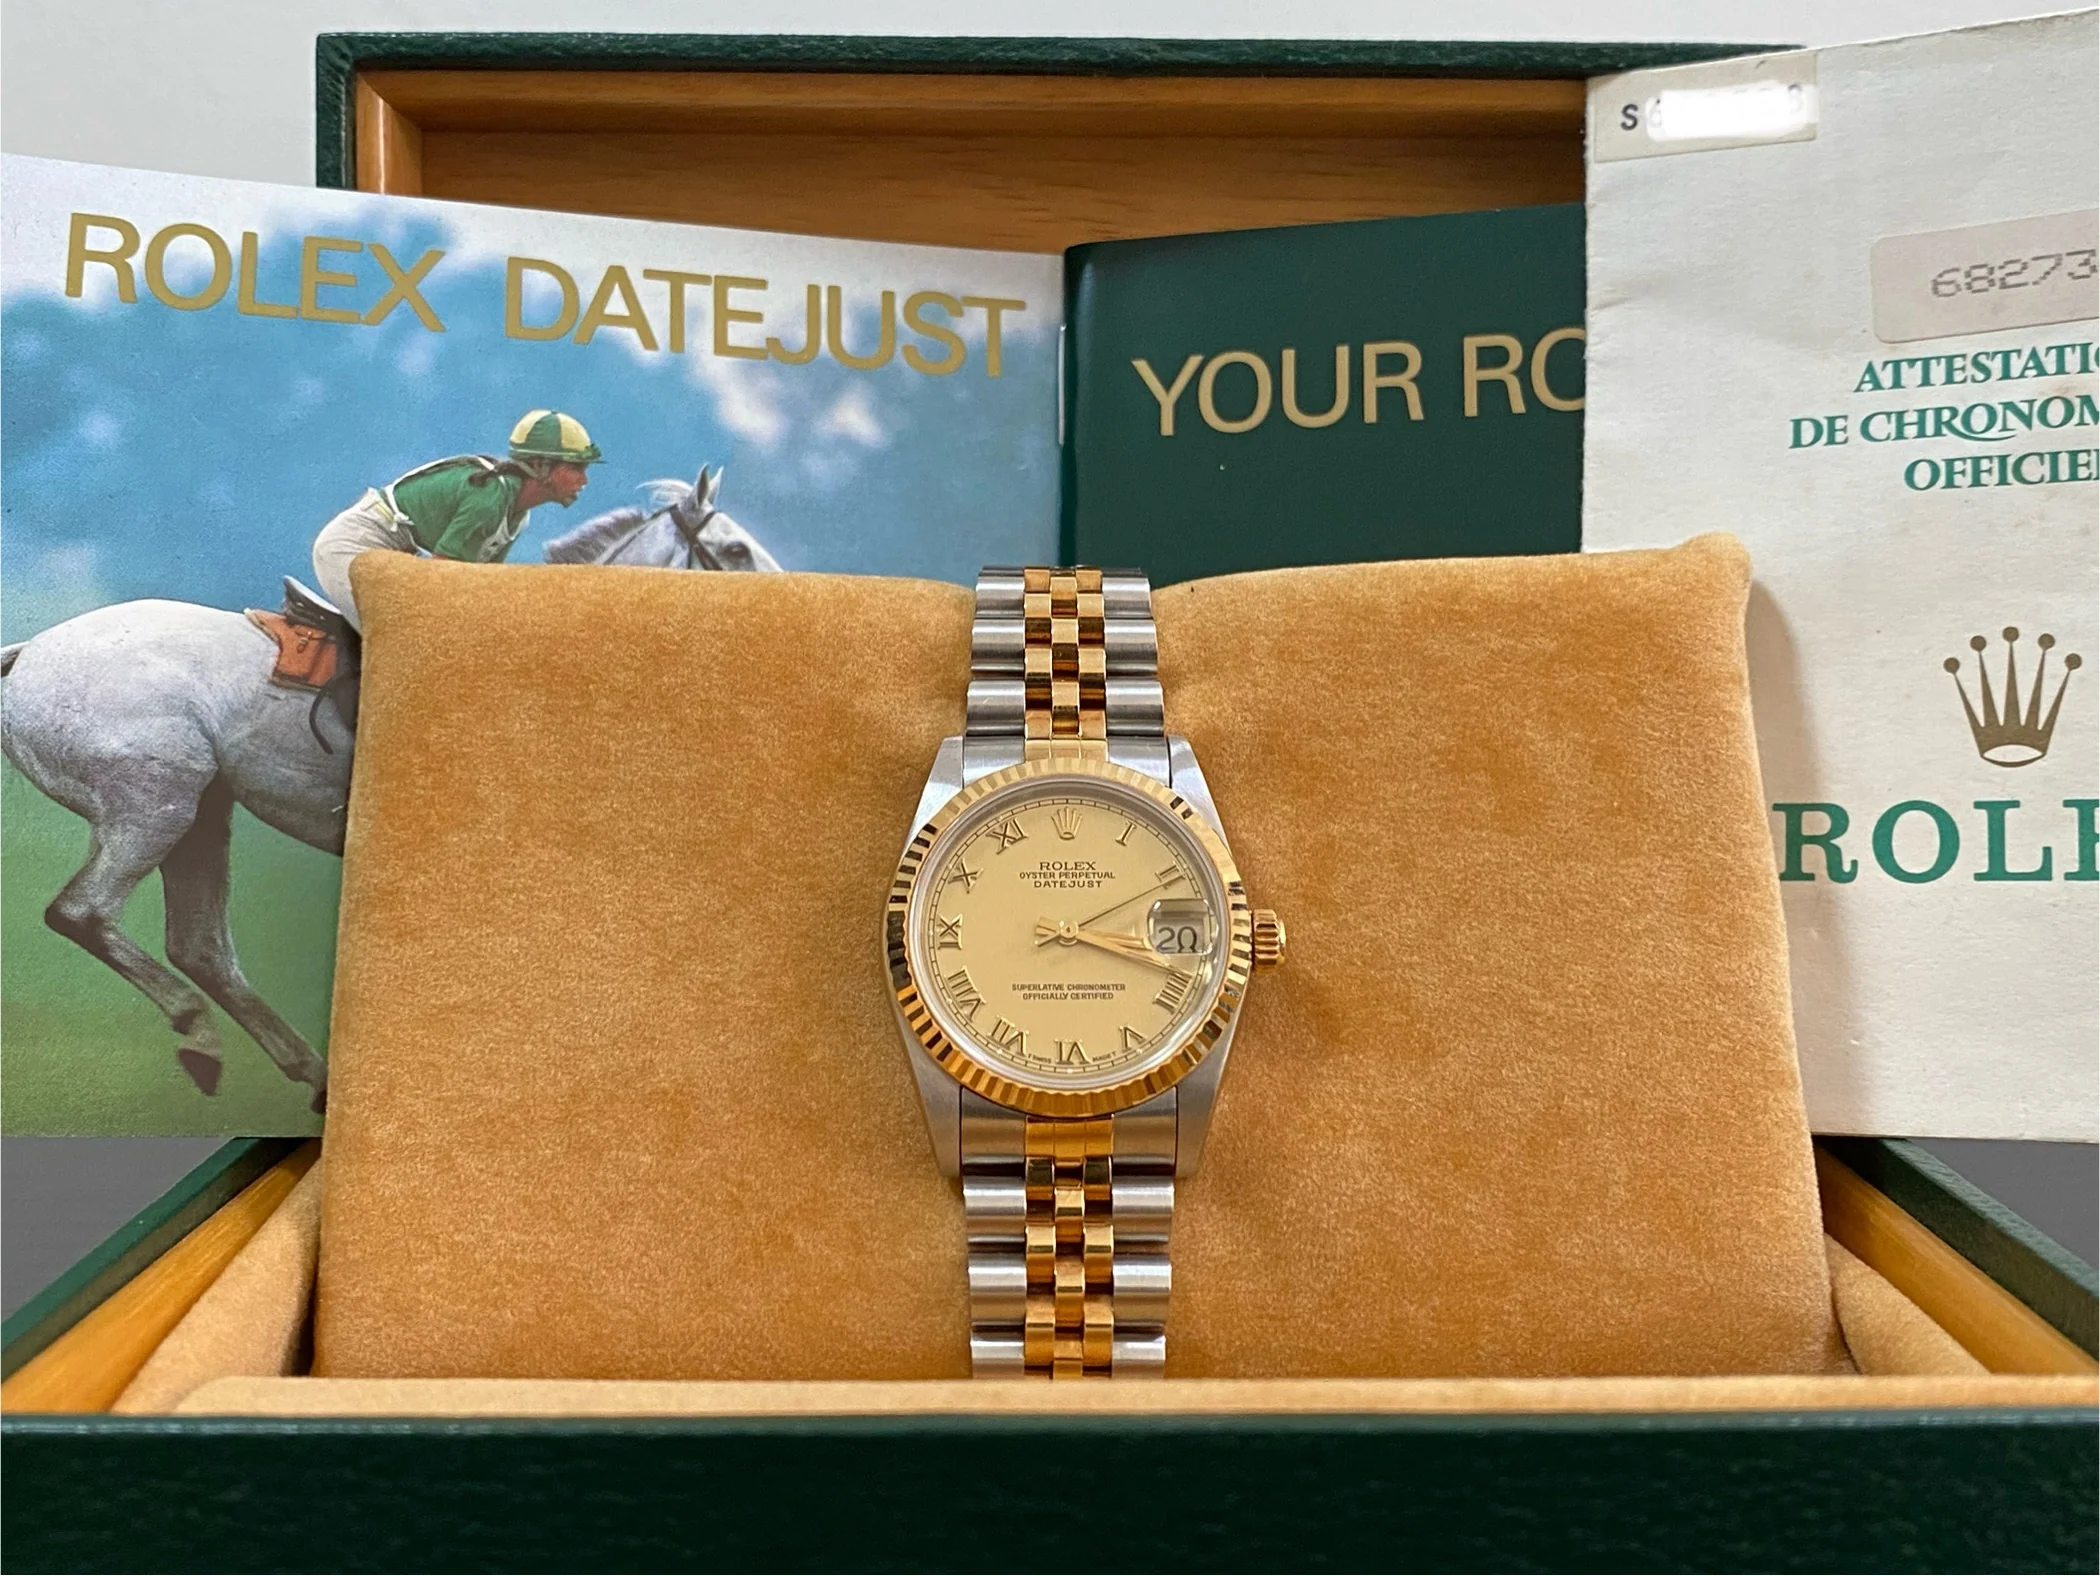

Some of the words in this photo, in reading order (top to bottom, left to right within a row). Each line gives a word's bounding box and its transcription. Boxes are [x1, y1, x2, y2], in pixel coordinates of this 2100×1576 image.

[1931, 248, 2099, 298] 68273
[64, 211, 447, 334] ROLEX
[502, 255, 1028, 379] DATEJUST
[1853, 341, 2099, 393] ATTESTATI
[1131, 339, 1425, 437] YOUR
[1788, 414, 1849, 450] DE
[1903, 447, 2099, 492] OFFICIE
[1019, 871, 1056, 880] OYSTER
[1058, 871, 1116, 880] PERPETUAL
[1039, 861, 1097, 871] ROLEX
[1033, 880, 1103, 889] DATEJUST
[1011, 983, 1065, 992] SUPERLATIVE
[1066, 983, 1126, 992] CHRONOMETER
[1022, 992, 1069, 1000] OFFICIALLY
[1070, 992, 1114, 1000] CERTIFIED
